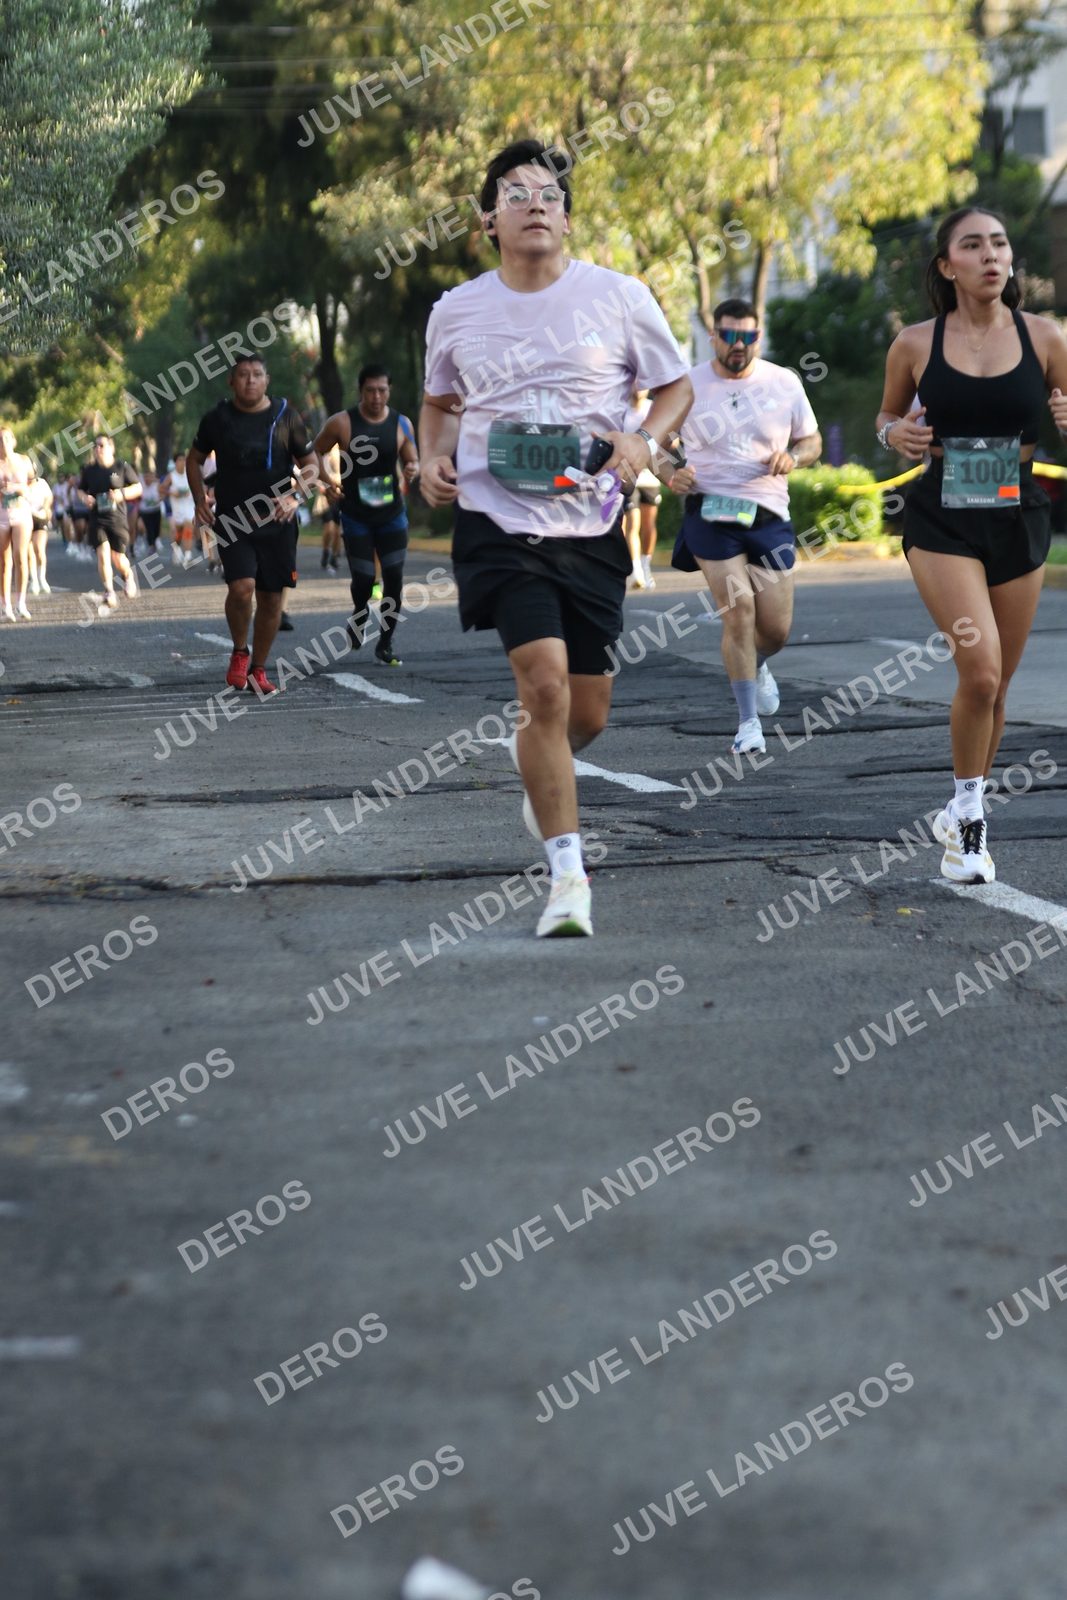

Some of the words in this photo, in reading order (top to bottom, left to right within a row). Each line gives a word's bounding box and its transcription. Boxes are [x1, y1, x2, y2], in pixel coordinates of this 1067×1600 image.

[512, 443, 577, 472] 1003
[960, 458, 1018, 484] 1002
[716, 498, 754, 511] 1447
